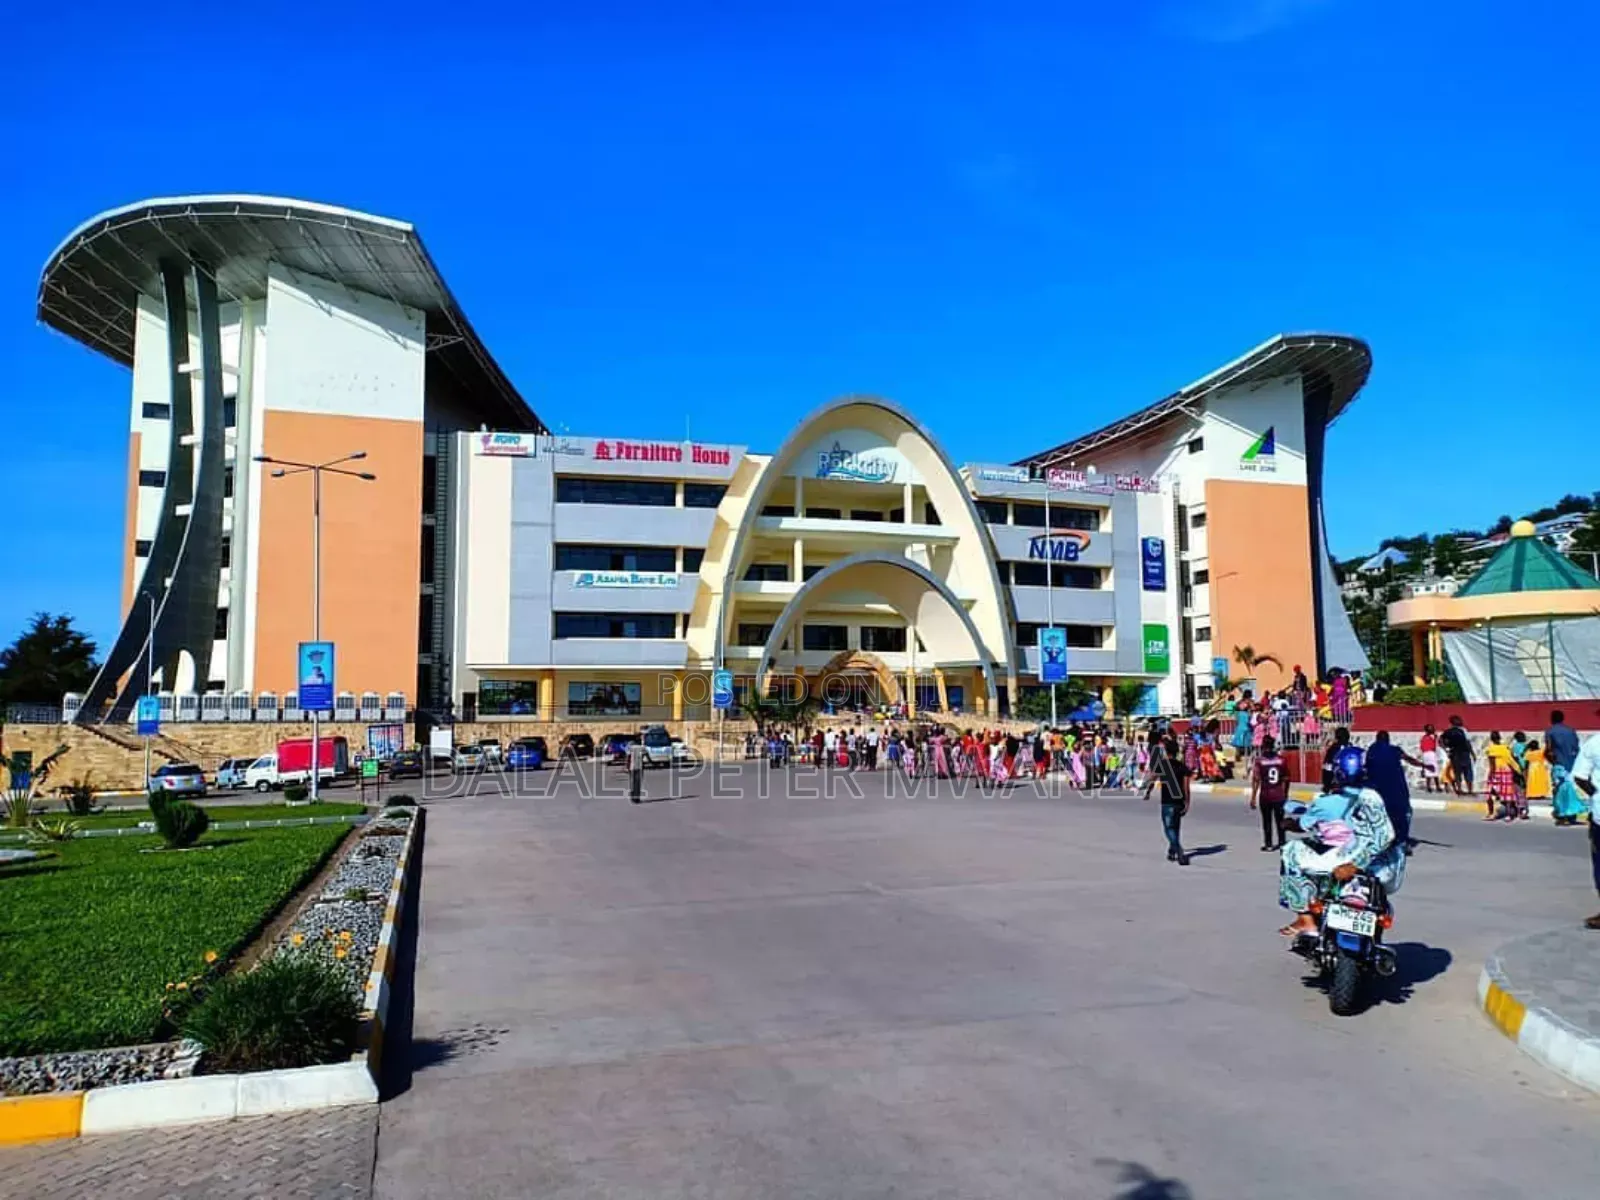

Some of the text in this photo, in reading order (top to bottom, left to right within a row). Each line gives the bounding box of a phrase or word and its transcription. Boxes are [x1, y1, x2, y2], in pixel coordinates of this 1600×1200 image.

[615, 441, 731, 465] Furniture House
[1029, 537, 1079, 562] NMB
[1268, 767, 1279, 785] 9
